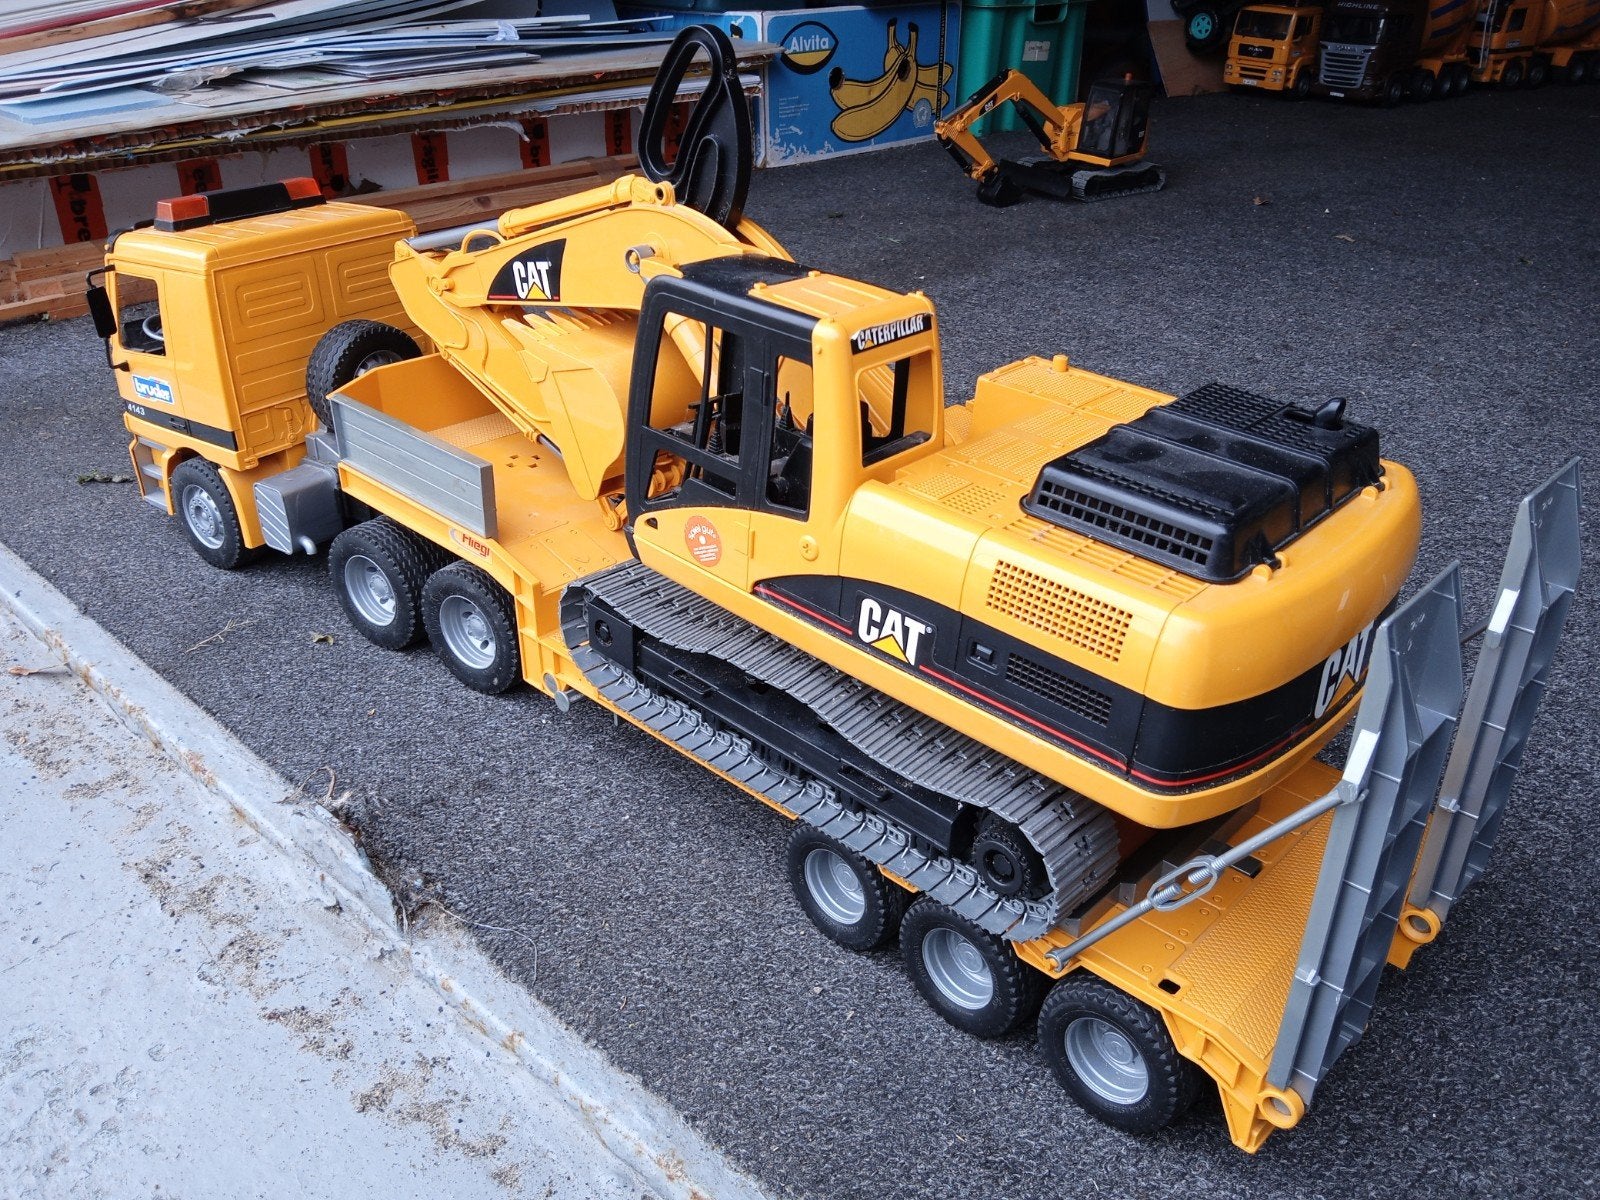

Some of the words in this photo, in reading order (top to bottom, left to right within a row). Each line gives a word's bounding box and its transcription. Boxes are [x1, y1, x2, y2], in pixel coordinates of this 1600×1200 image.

[1337, 2, 1378, 10] HIGHLINE
[790, 35, 829, 52] Alvita
[512, 260, 552, 300] CAT
[857, 314, 924, 350] CATERPILLAR
[134, 377, 171, 402] bruder
[127, 403, 146, 416] 4143
[858, 598, 927, 667] CAT
[1314, 620, 1375, 720] CAT
